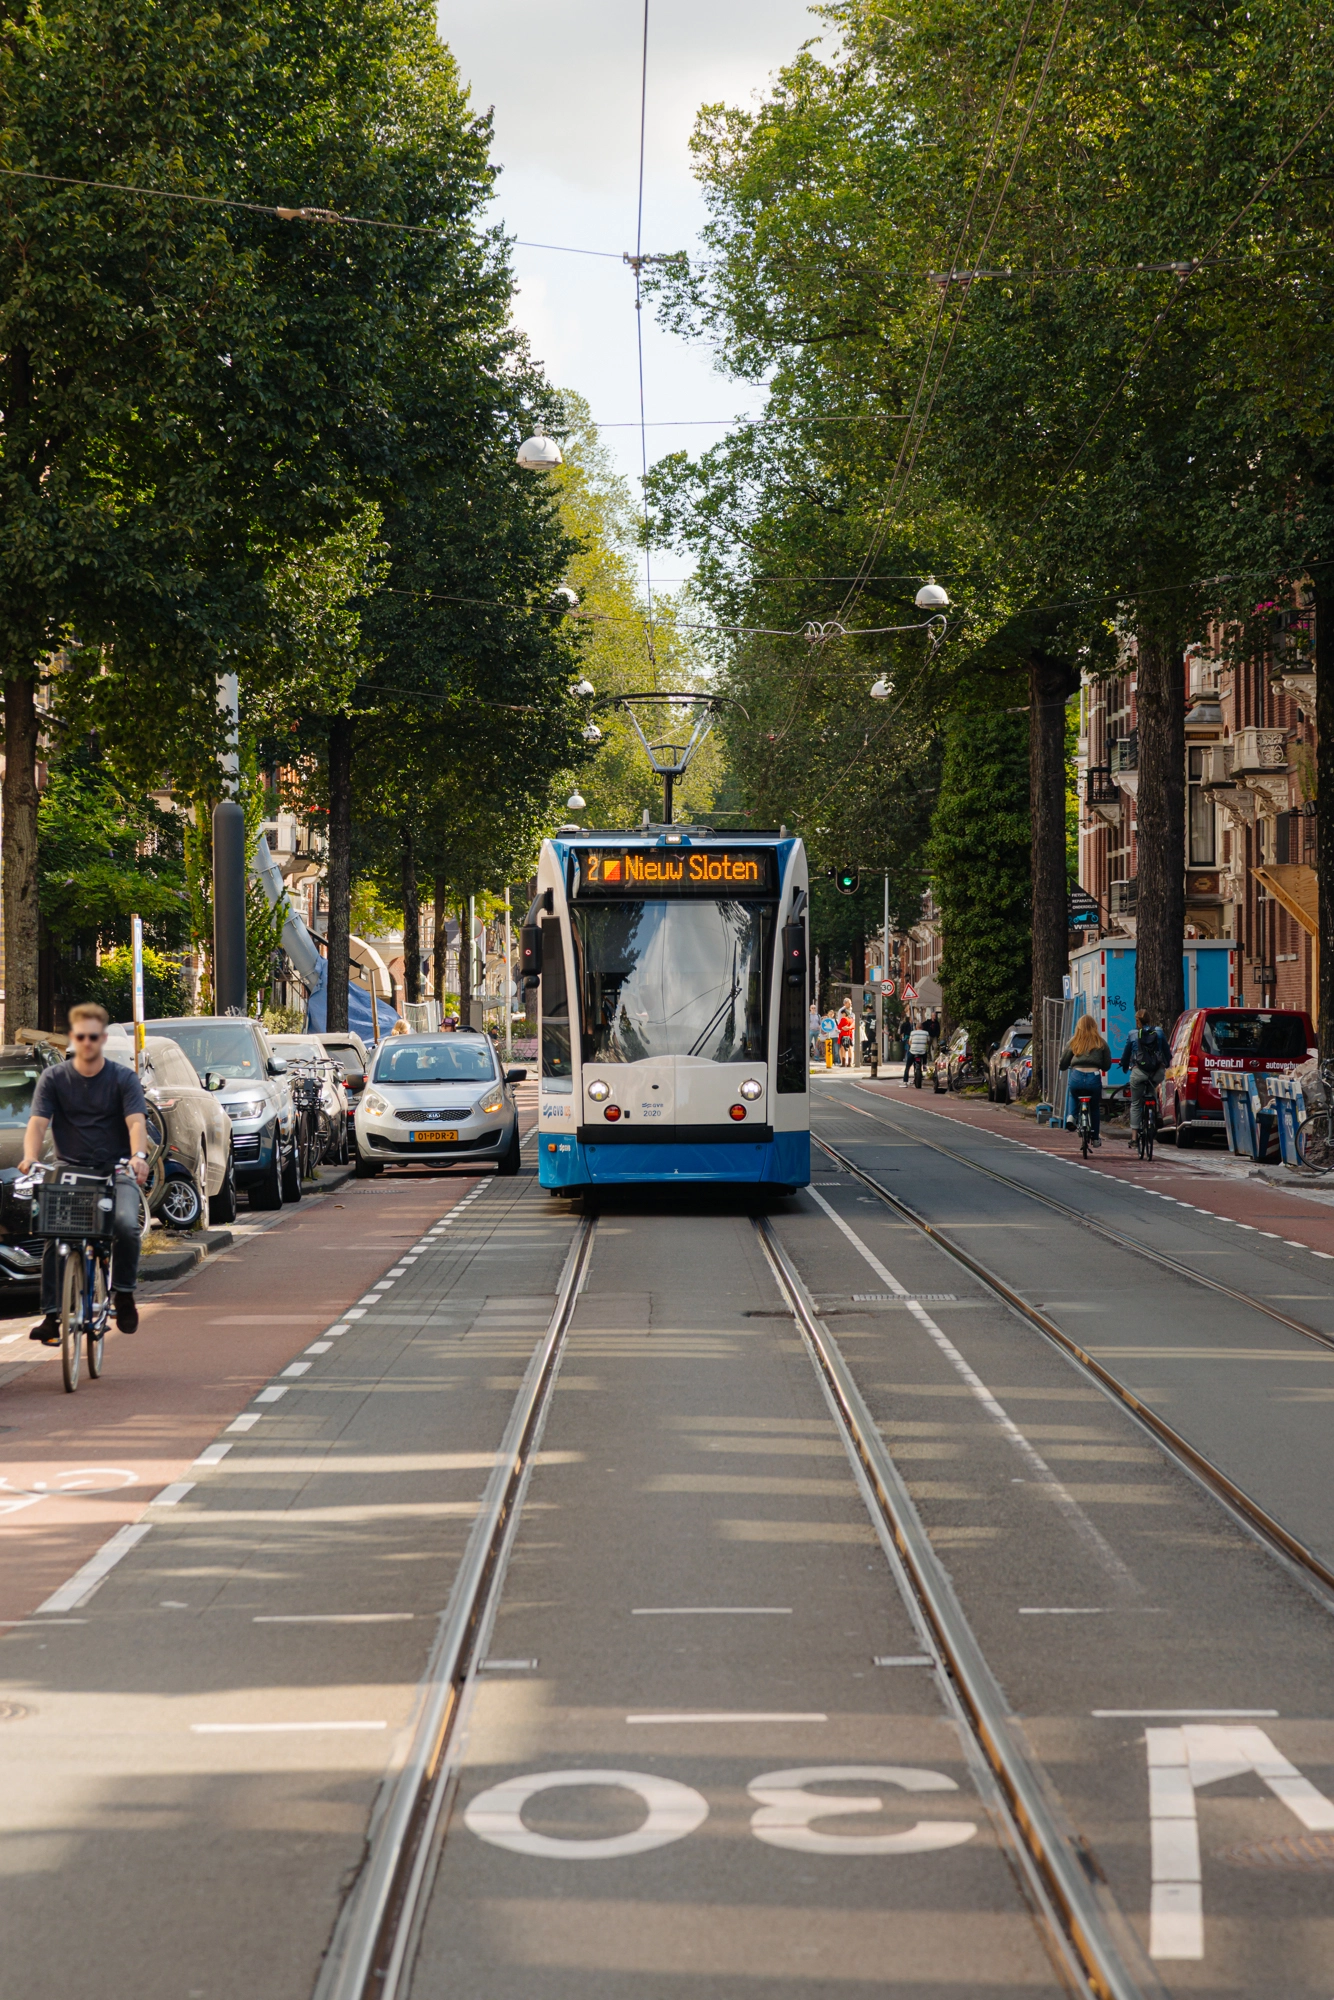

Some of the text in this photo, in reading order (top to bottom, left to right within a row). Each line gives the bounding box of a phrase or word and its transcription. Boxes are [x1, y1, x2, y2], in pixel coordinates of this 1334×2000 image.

[587, 854, 758, 881] 2 Nieuw Sloten
[1064, 978, 1070, 997] P
[1204, 1057, 1244, 1068] bo-rent.nl
[552, 1105, 564, 1117] GVB
[417, 1131, 455, 1141] 01-PDR-2
